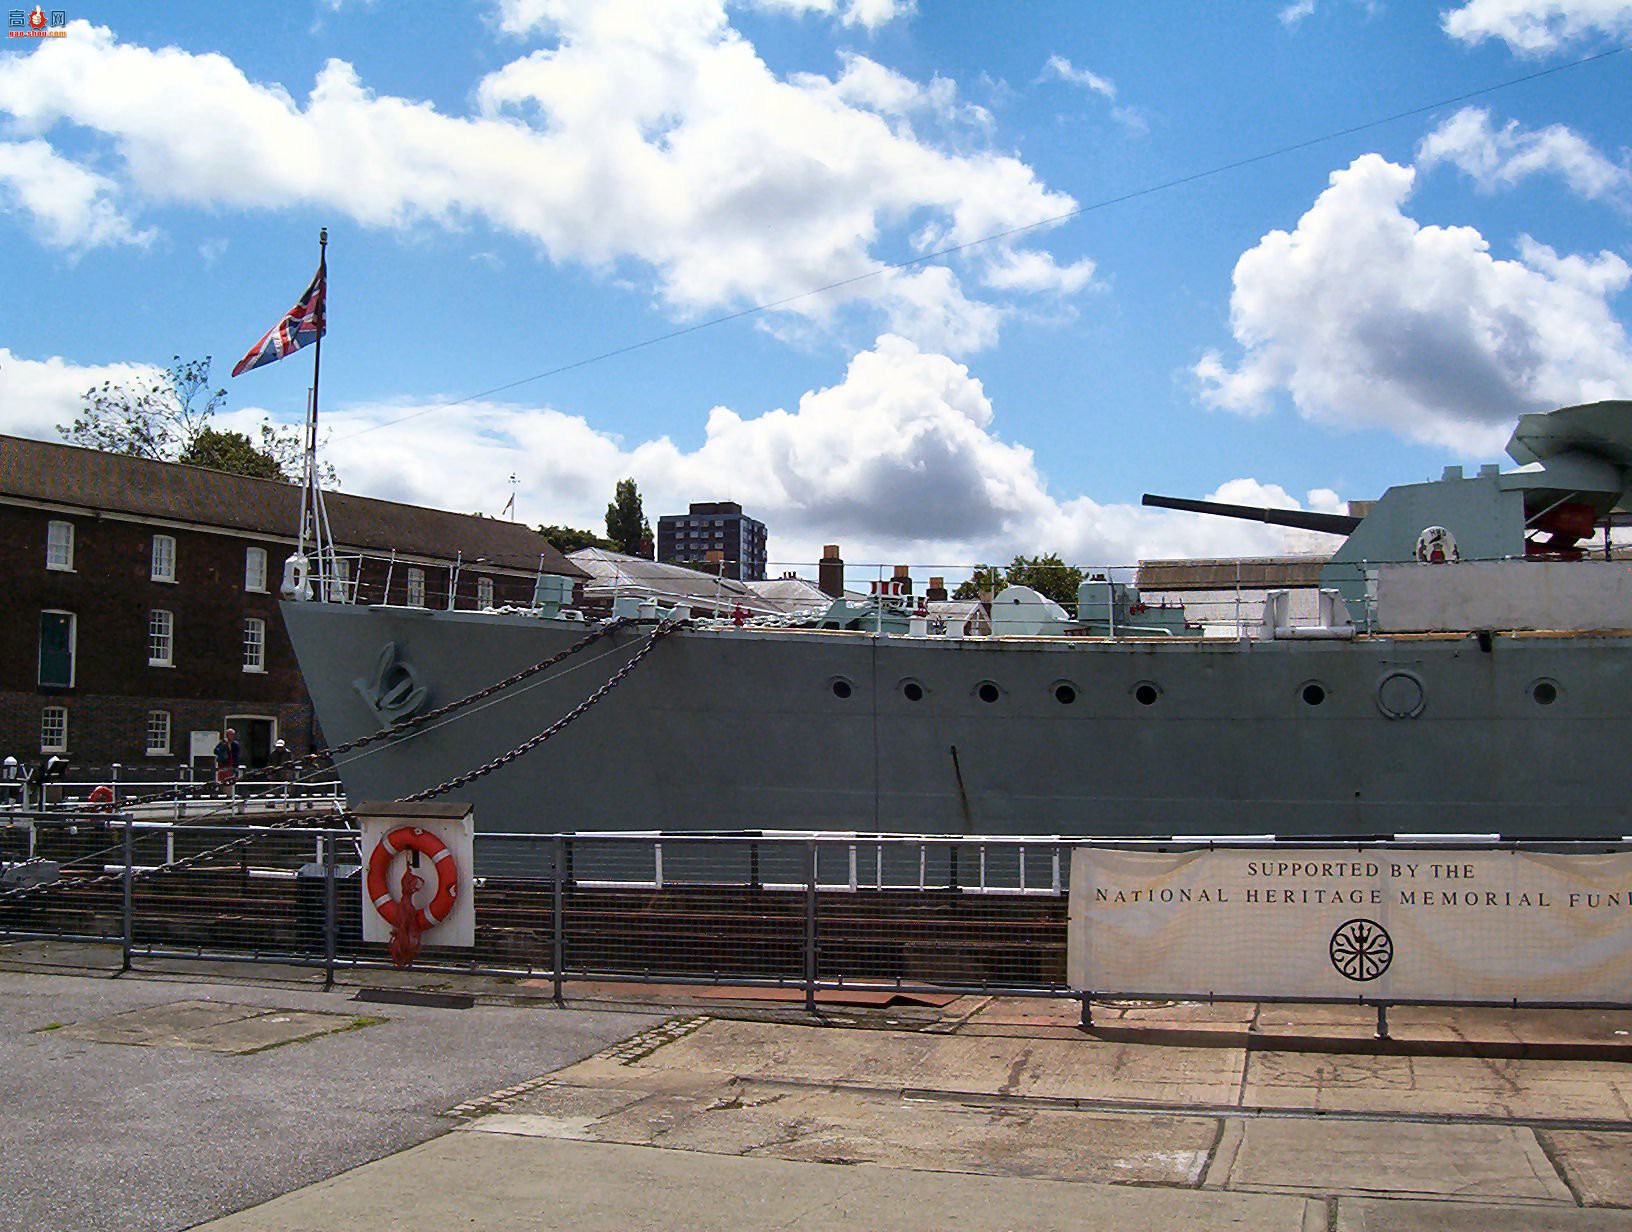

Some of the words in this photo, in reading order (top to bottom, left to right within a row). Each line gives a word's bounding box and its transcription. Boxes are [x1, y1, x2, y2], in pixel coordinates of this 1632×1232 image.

[1248, 862, 1379, 877] SUPPORTED
[1391, 864, 1418, 878] BY
[1431, 864, 1475, 878] THE
[1096, 888, 1228, 902] NATIONAL
[1247, 889, 1381, 904] HERITAGE
[1400, 891, 1551, 906] MEMORIAL
